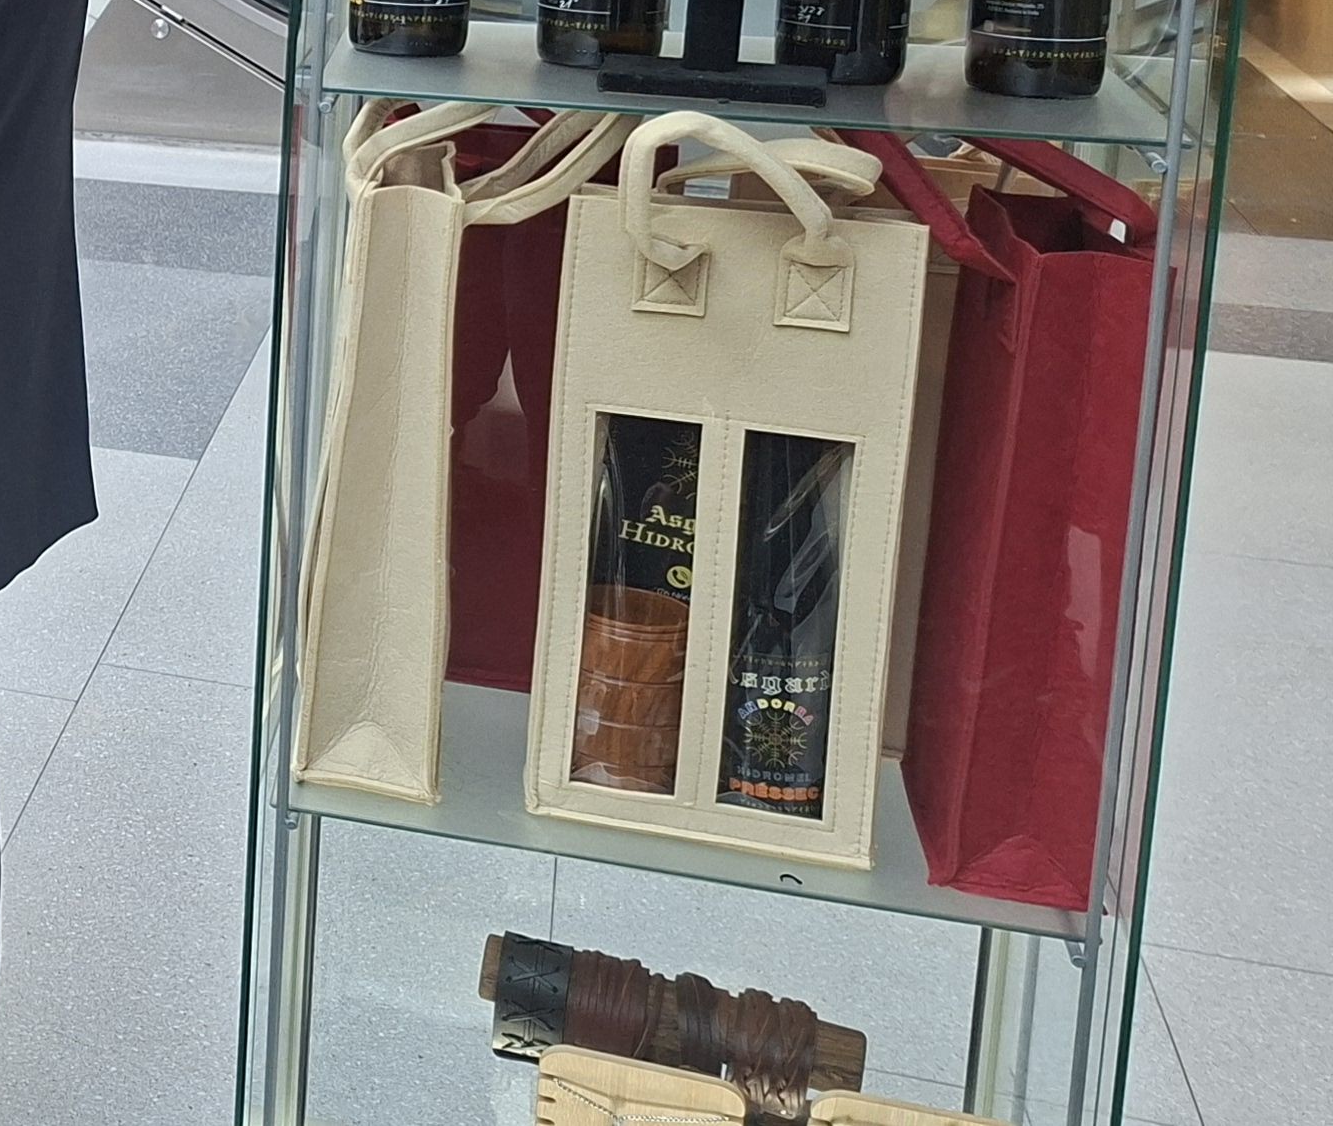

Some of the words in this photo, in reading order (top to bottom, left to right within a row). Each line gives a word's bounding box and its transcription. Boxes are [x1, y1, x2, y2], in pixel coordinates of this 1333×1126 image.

[645, 505, 696, 536] Asg
[618, 519, 695, 554] HIDRO
[730, 670, 830, 696] sgard
[738, 698, 814, 726] ANDORRA
